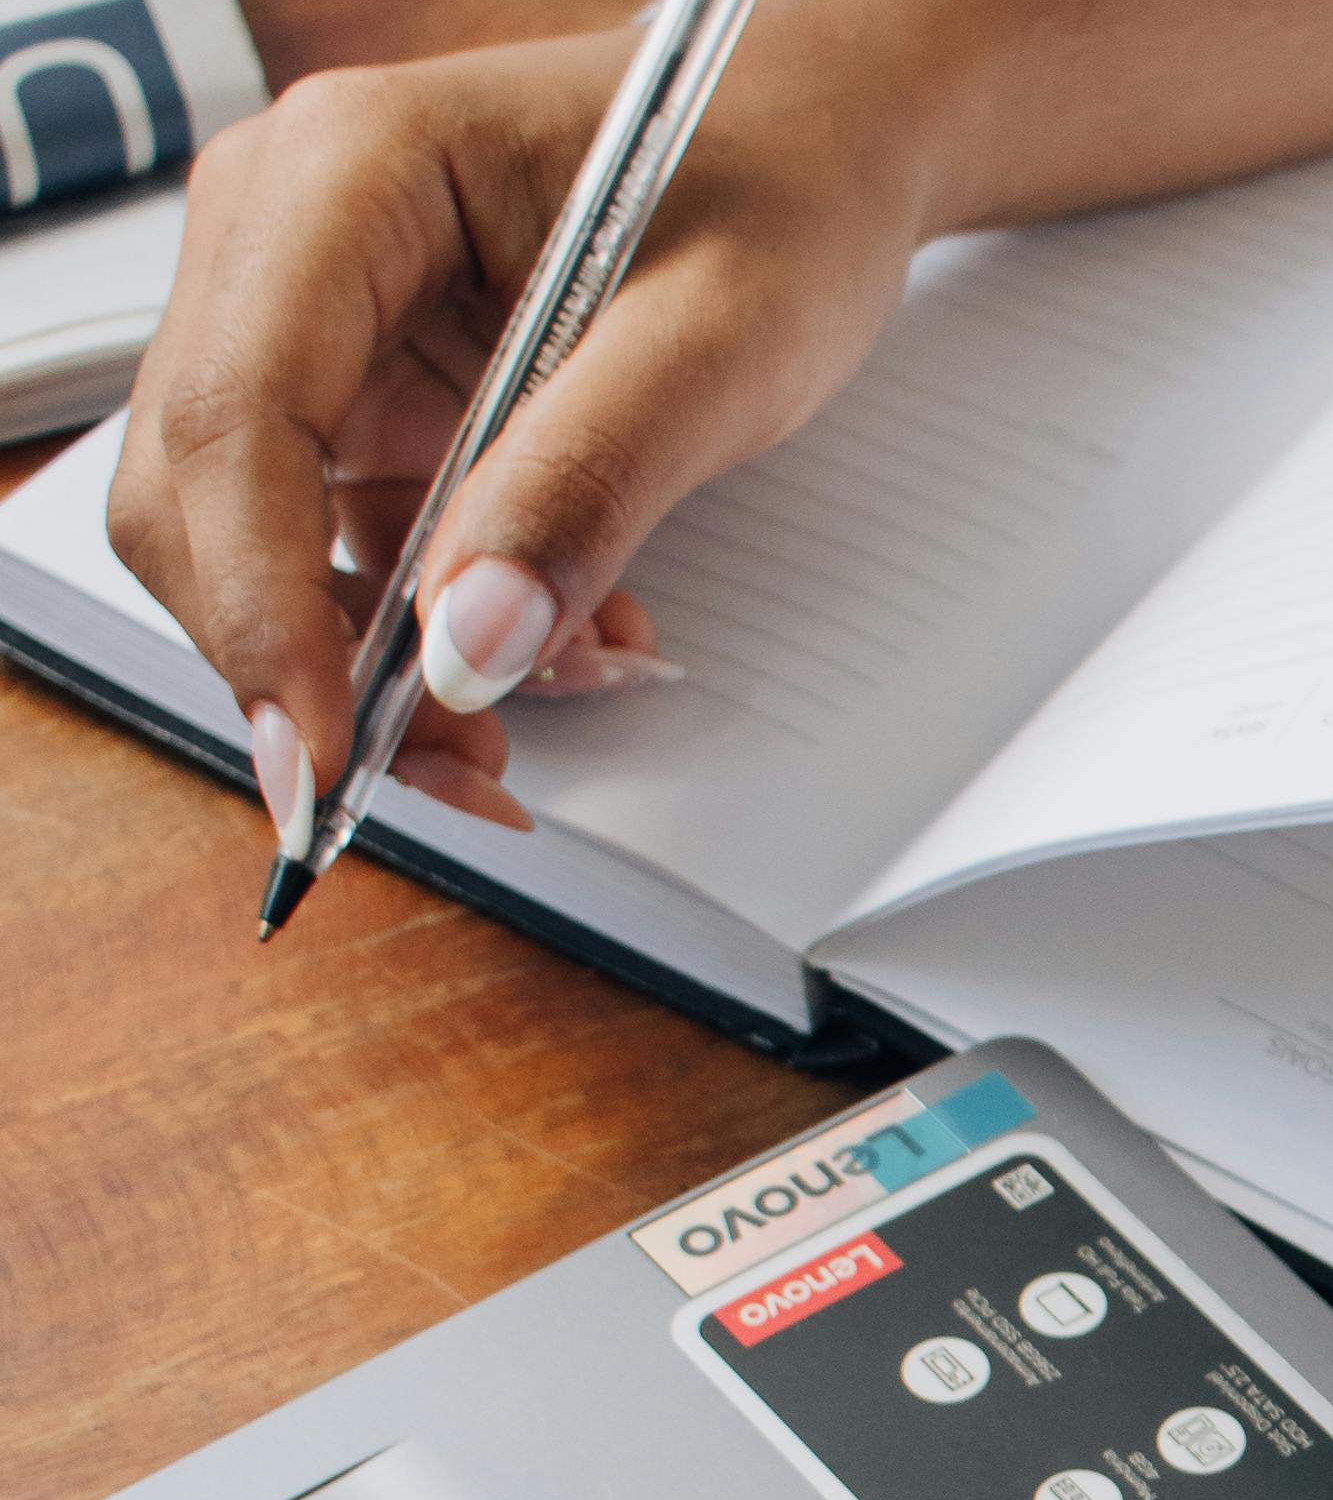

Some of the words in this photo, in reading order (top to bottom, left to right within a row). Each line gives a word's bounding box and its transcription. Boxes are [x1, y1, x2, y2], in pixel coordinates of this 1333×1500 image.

[678, 1122, 926, 1257] Lenovo
[738, 1243, 884, 1327] Lenovo
[1245, 1382, 1286, 1421] SATA
[1278, 1417, 1313, 1449] HDD
